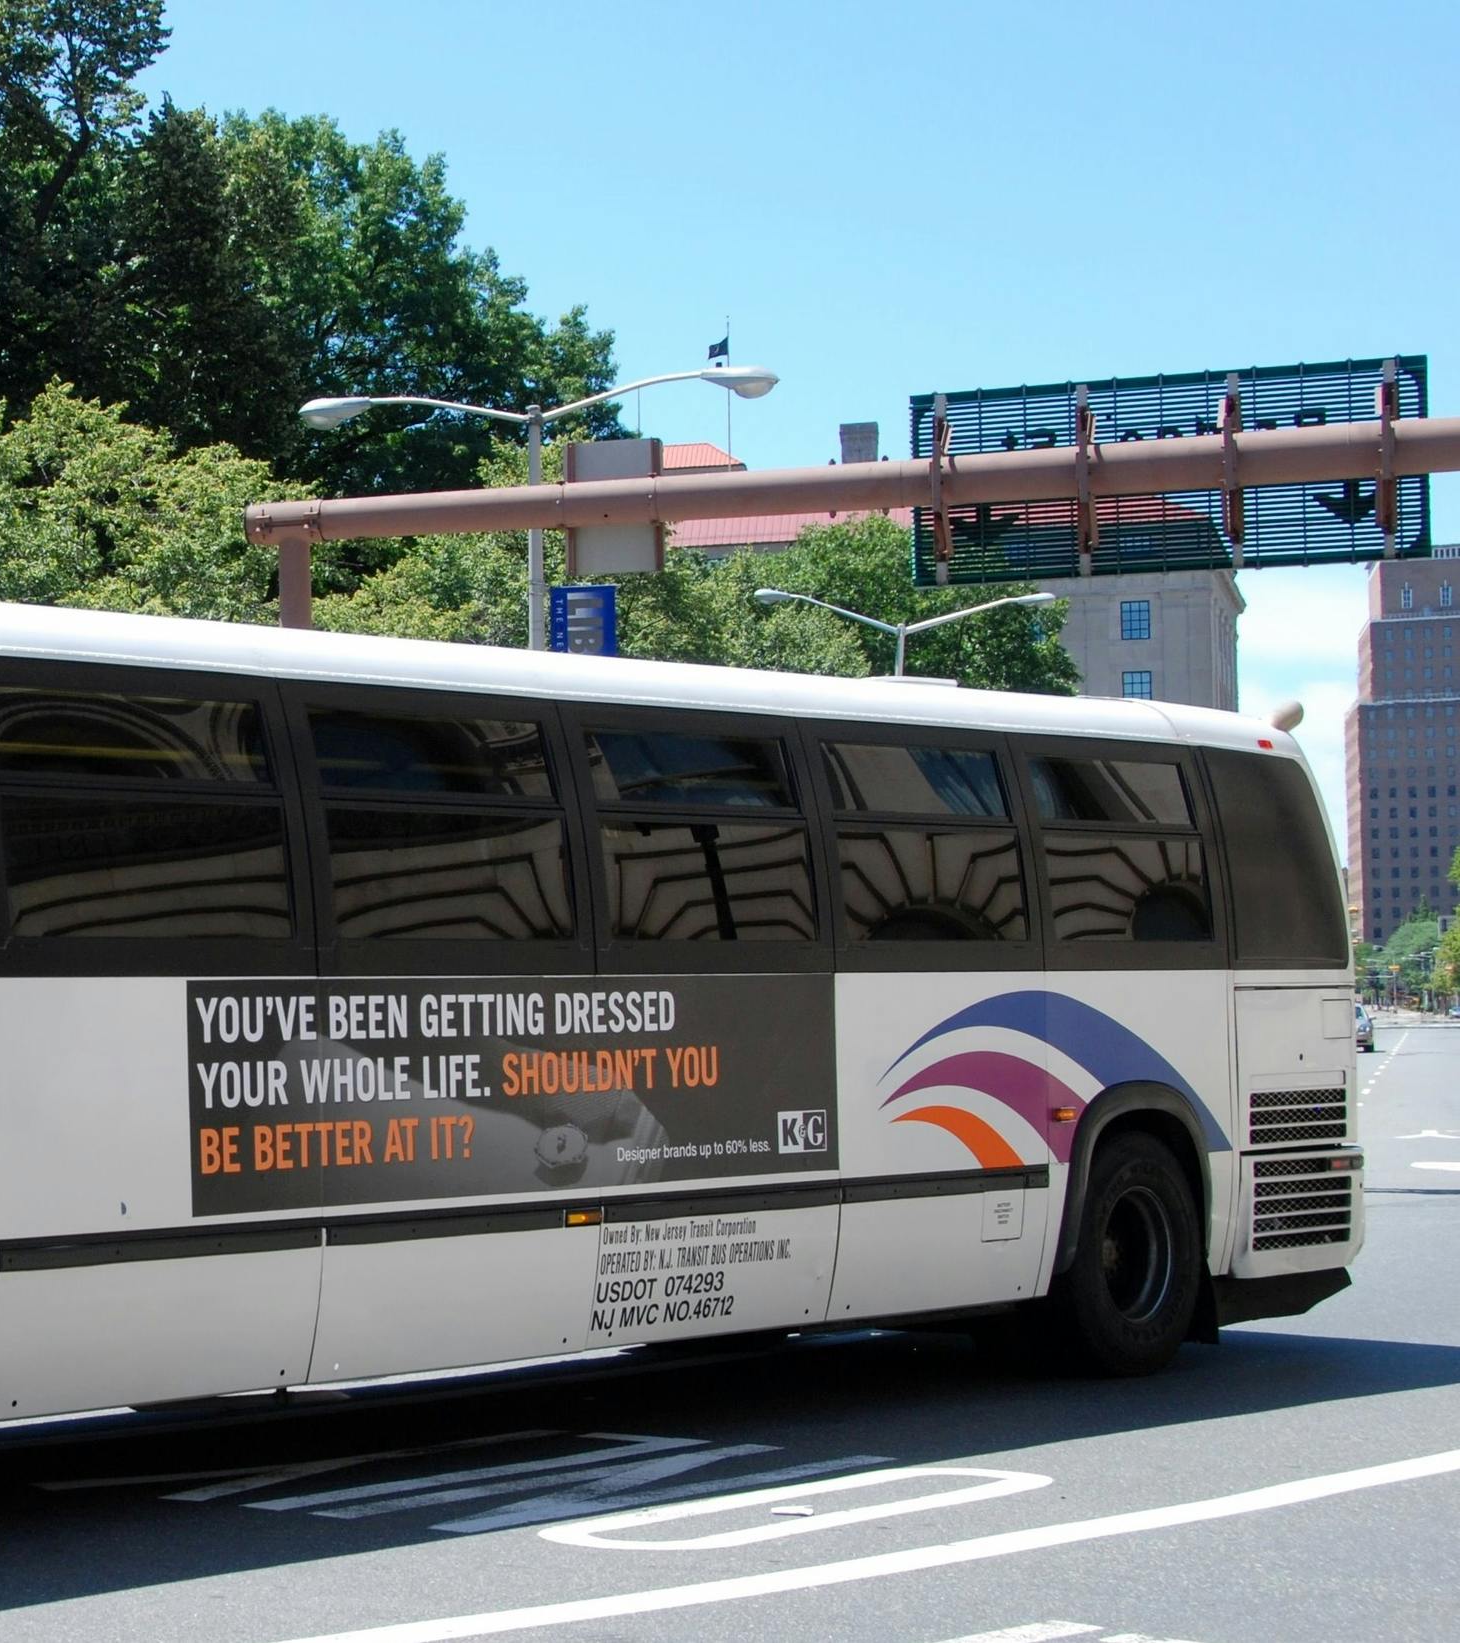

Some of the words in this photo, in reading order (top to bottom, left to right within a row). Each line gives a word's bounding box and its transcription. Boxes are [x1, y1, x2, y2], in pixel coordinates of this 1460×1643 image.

[196, 995, 318, 1043] YOU'VE
[329, 994, 408, 1040] BEEN
[420, 992, 545, 1038] GETTING
[555, 990, 676, 1036] DRESSED
[197, 1060, 289, 1109] YOUR
[300, 1056, 412, 1104] WHOLE
[423, 1054, 491, 1099] LIFE.
[502, 1048, 657, 1097] SHOULDN'T
[666, 1046, 719, 1088] YOU
[199, 1126, 242, 1175] BE
[253, 1119, 373, 1171] BETTER
[383, 1118, 419, 1163] AT
[430, 1114, 476, 1161] IT?
[781, 1114, 824, 1148] K&G
[616, 1146, 661, 1164] Designer
[663, 1143, 698, 1161] brands
[699, 1145, 712, 1159] up
[714, 1142, 724, 1155] to
[725, 1140, 748, 1155] 60%
[749, 1138, 772, 1153] less.
[603, 1226, 629, 1245] Owned
[645, 1223, 661, 1242] New
[662, 1222, 687, 1242] Jersey
[689, 1219, 714, 1239] Transit
[716, 1216, 757, 1238] Corporation
[600, 1251, 641, 1275] OPERATED
[659, 1247, 674, 1270] N.J.
[676, 1244, 710, 1269] TRANSIT
[711, 1243, 727, 1265] BUS
[729, 1239, 775, 1264] OPERATIONS
[777, 1237, 791, 1260] INC.
[596, 1278, 657, 1303] USDOT
[664, 1271, 725, 1297] 074293
[590, 1309, 616, 1331] NJ
[619, 1303, 659, 1328] MVC
